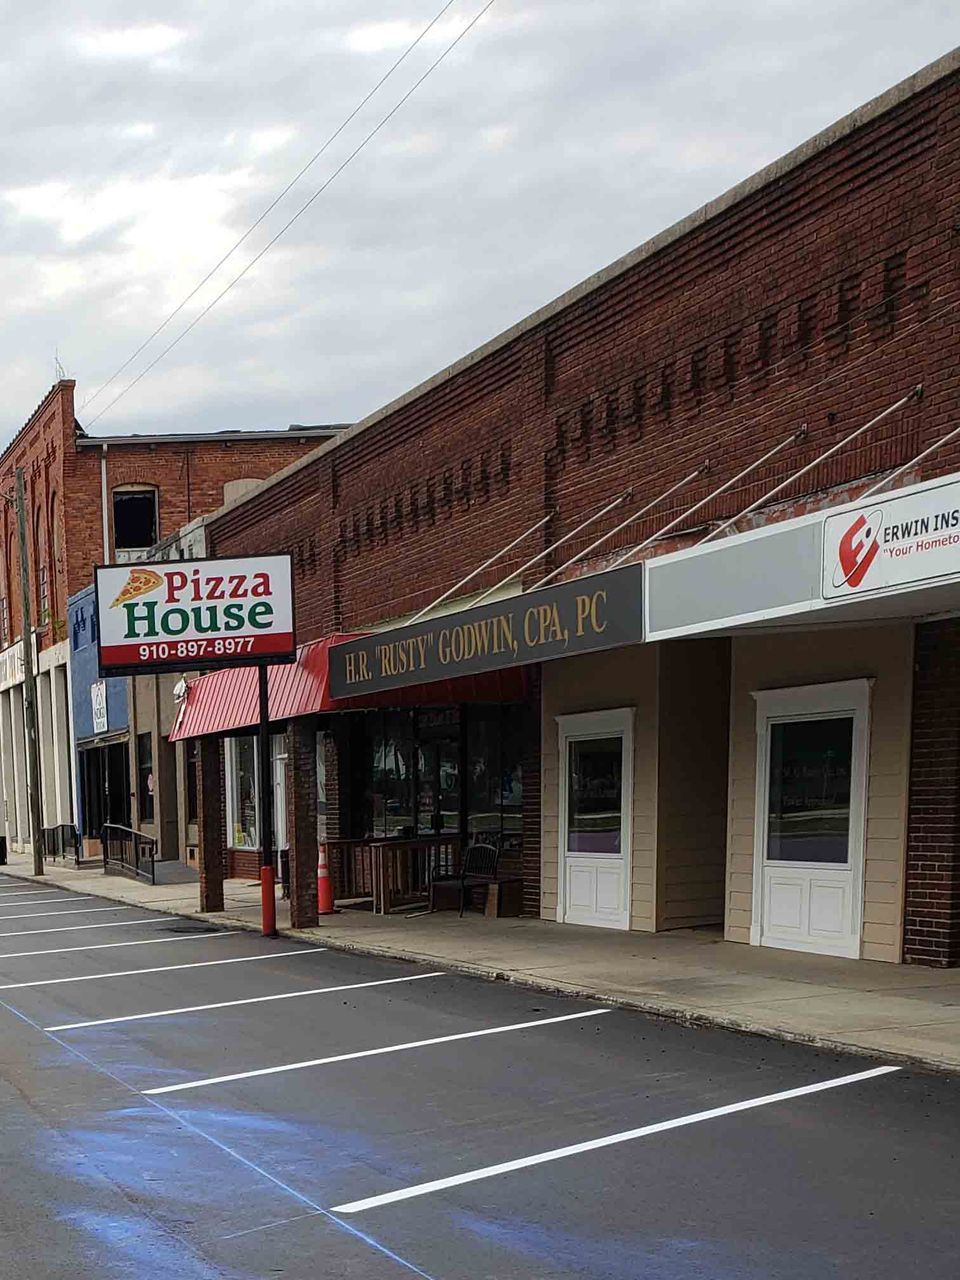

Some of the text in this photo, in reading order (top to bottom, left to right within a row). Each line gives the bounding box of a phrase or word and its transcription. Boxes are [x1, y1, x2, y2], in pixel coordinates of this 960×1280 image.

[883, 509, 960, 544] ERWIN INS
[883, 534, 960, 558] "Your Hometo
[164, 569, 273, 604] Pizza
[122, 601, 274, 639] House
[345, 590, 608, 685] H.R. "RUSTY" GODWIN, CPA, PC
[139, 637, 255, 660] 910-897-8977
